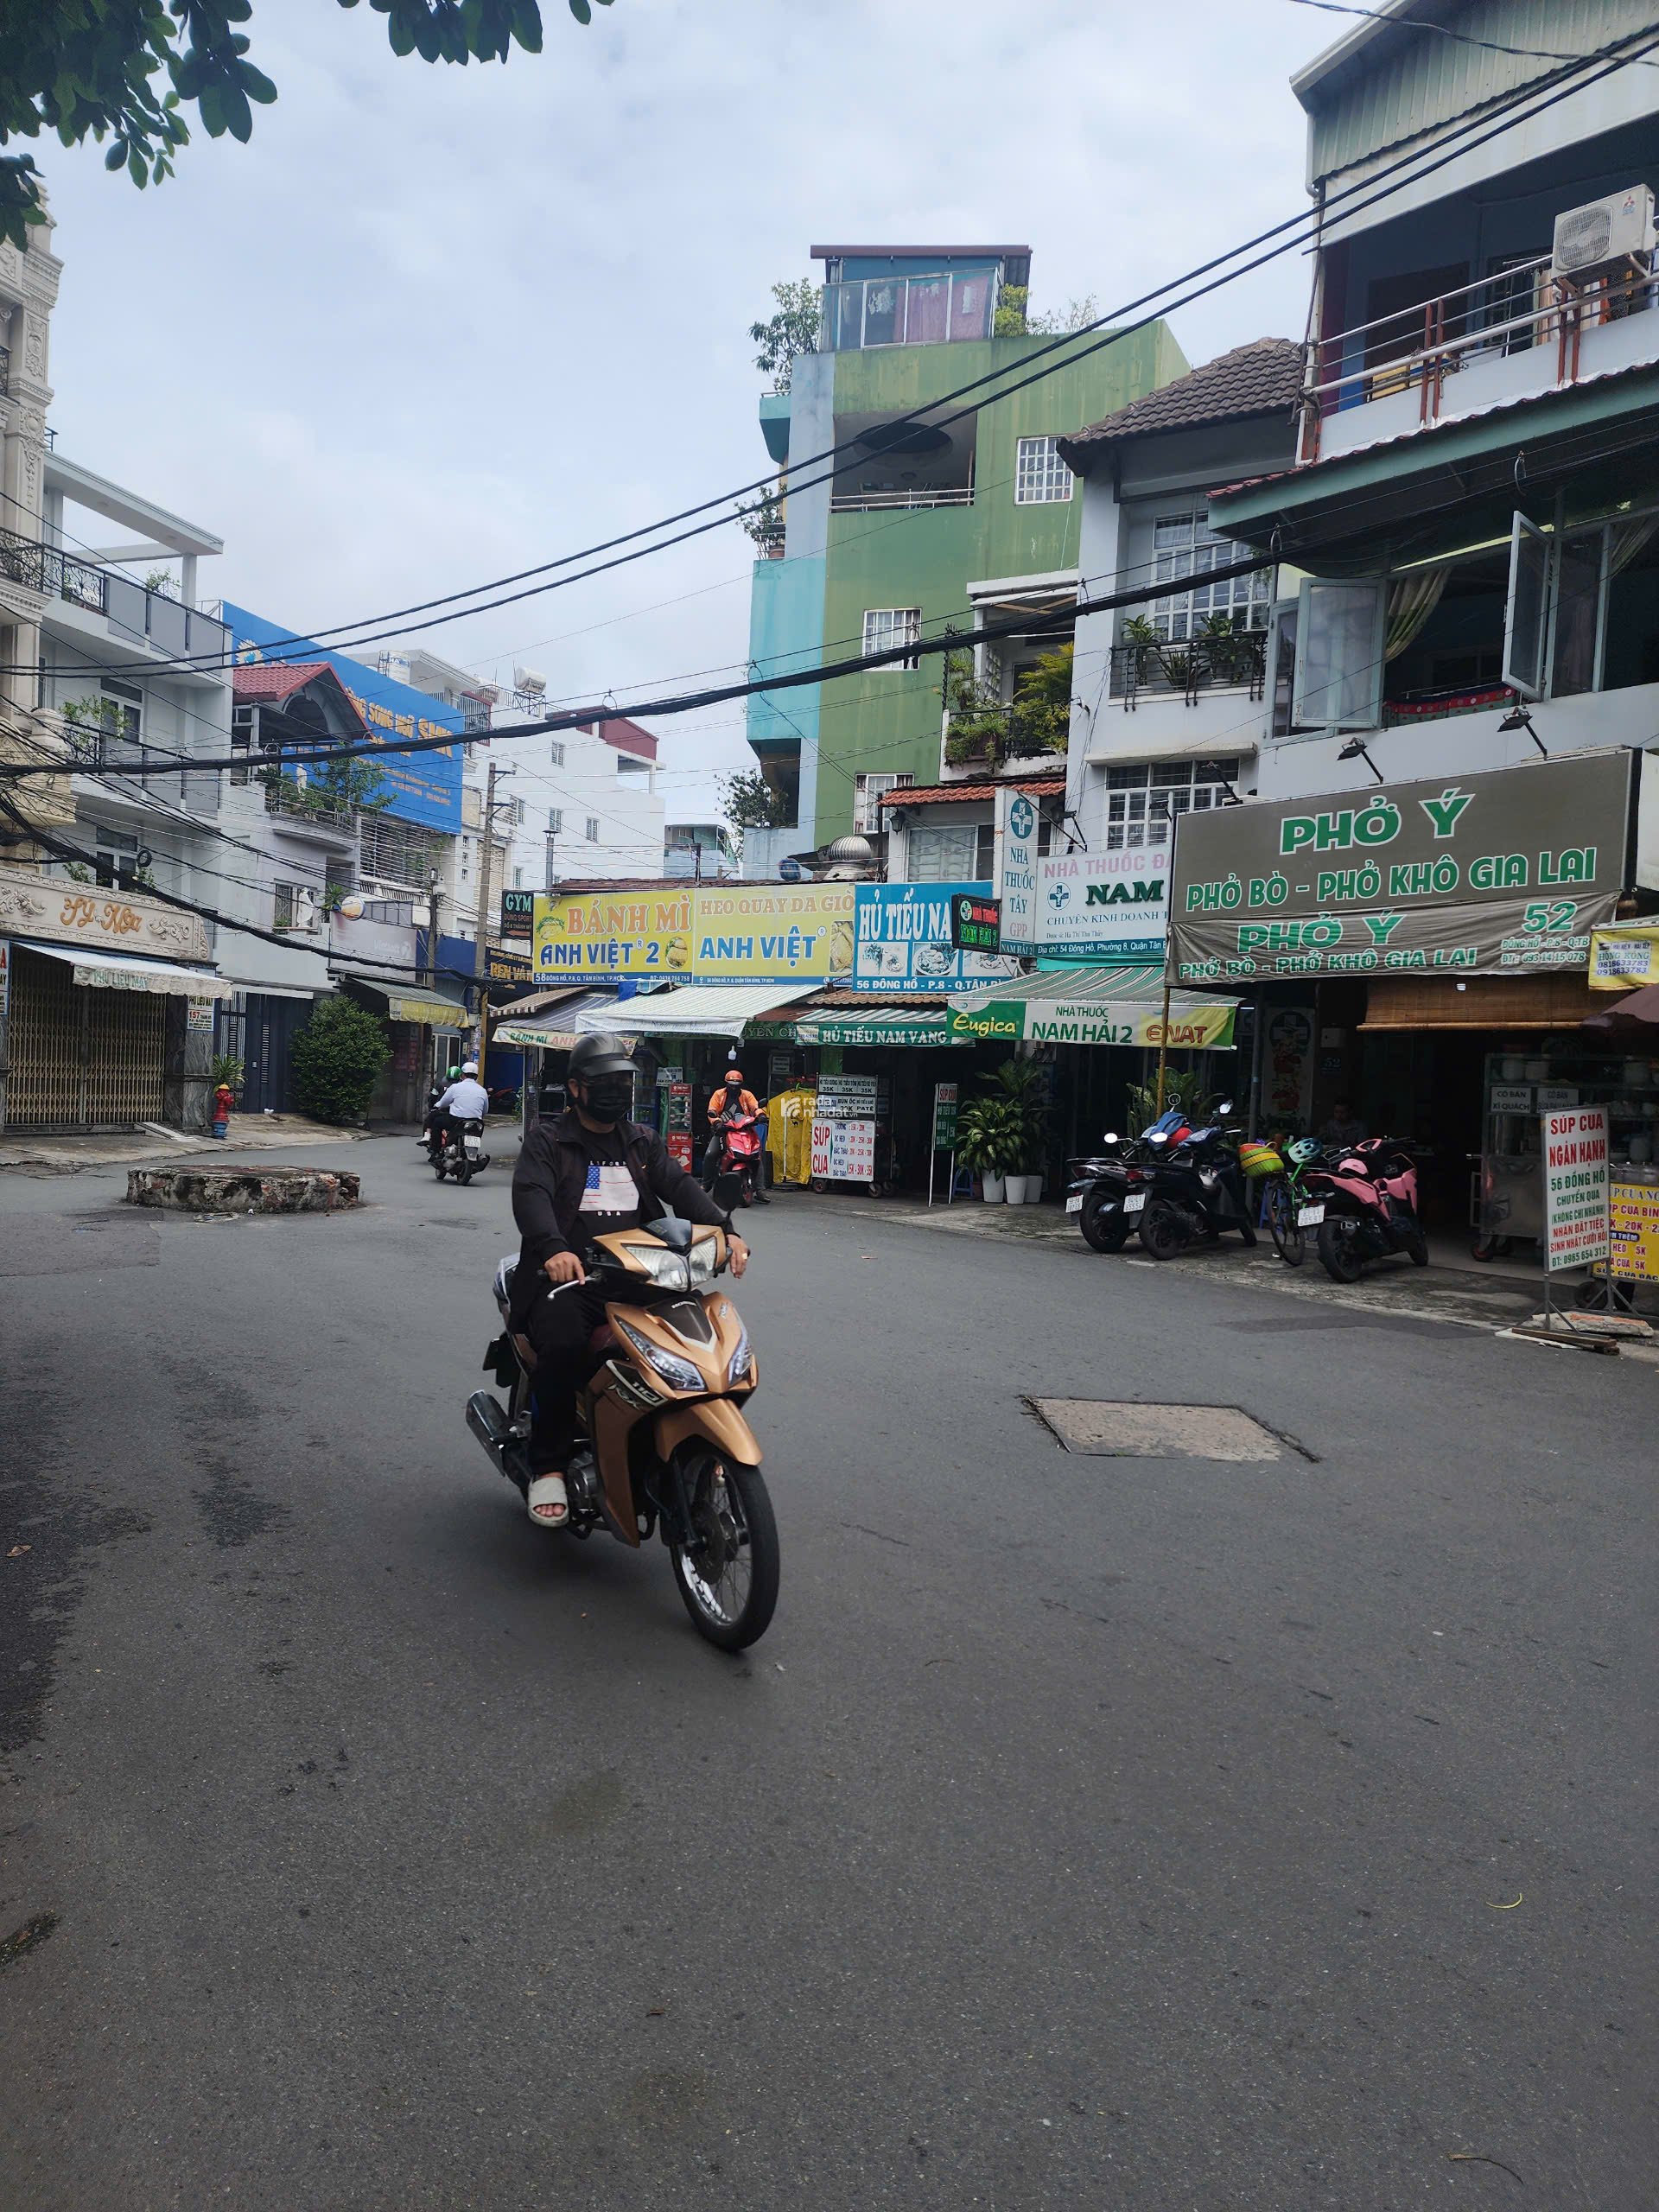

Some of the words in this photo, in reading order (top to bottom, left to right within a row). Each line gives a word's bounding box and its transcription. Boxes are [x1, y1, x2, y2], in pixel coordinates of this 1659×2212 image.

[1280, 795, 1402, 855] PHỞ
[1418, 786, 1476, 839] Ý
[1044, 859, 1079, 878] NHÀ
[1085, 851, 1146, 875] THUỐC
[1005, 870, 1035, 891] THUỐC
[1186, 873, 1242, 912] PHỞ
[1249, 871, 1288, 907] BÒ
[1317, 860, 1381, 902] PHỞ
[1389, 854, 1459, 896] KHÔ
[1469, 854, 1529, 890] GIA
[1538, 847, 1597, 886] LAI
[505, 893, 532, 912] GYM
[701, 899, 735, 916] HEO
[738, 897, 788, 914] QUAY
[791, 896, 817, 913] DA
[821, 889, 855, 912] GIÒ
[1085, 880, 1164, 906] NAM
[859, 889, 882, 940] HỦ
[887, 887, 925, 940] TIẾU
[1010, 894, 1027, 914] TÂY
[567, 899, 650, 936] BÁNH
[654, 893, 691, 933] MÌ
[1046, 914, 1089, 925] CHUYÊN
[1091, 912, 1117, 924] KINH
[1121, 911, 1159, 921] DOANH
[1521, 901, 1578, 933] 52
[1010, 922, 1027, 938] GPP
[1237, 912, 1343, 954] PHỞ
[1362, 908, 1407, 946] Ý
[540, 943, 582, 968] ANH
[587, 938, 633, 969] VIỆT
[645, 941, 659, 964] 2
[699, 936, 753, 959] ANH
[760, 925, 817, 967] VIỆT
[1001, 944, 1016, 955] NAM
[1029, 947, 1033, 956] 2
[1097, 943, 1122, 953] Phường
[1130, 942, 1147, 951] Quận
[1179, 957, 1221, 979] PHỞ
[1225, 956, 1256, 976] BÒ
[1275, 950, 1324, 973] PHỞ
[1327, 948, 1378, 970] KHÔ
[1385, 950, 1426, 969] GIA
[1433, 947, 1478, 967] LAI
[535, 973, 545, 982] 58
[856, 980, 869, 989] 56
[928, 980, 945, 989] P.8
[1056, 1006, 1075, 1017] NHÀ
[1077, 1005, 1109, 1018] THUỐC
[823, 1026, 840, 1043] HỦ
[843, 1026, 873, 1044] TIẾU
[876, 1031, 906, 1043] NAM
[908, 1031, 947, 1044] VANG
[952, 1014, 1017, 1037] Eugica
[1032, 1021, 1078, 1042] NAM
[1082, 1019, 1117, 1043] HẢI
[1120, 1026, 1132, 1044] 2
[813, 1122, 830, 1147] SÚP
[1550, 1115, 1576, 1135] SÚP
[1580, 1114, 1604, 1132] CUA
[1580, 1139, 1605, 1166] HẠNH
[813, 1154, 829, 1175] CUA
[1551, 1178, 1562, 1192] 56
[1556, 1189, 1585, 1207] CHUYỂN
[1586, 1190, 1600, 1201] QUA
[1621, 1205, 1639, 1217] CUA
[1587, 1217, 1605, 1235] TIỆC
[1624, 1220, 1643, 1231] 20K
[1550, 1241, 1566, 1253] SINH
[1563, 1251, 1580, 1264] 0965
[1581, 1249, 1593, 1260] 654
[1594, 1246, 1606, 1258] 312
[1612, 1243, 1626, 1253] HEO
[1636, 1246, 1646, 1256] 5K
[1617, 1258, 1630, 1268] CUA
[1635, 1261, 1645, 1270] 5K
